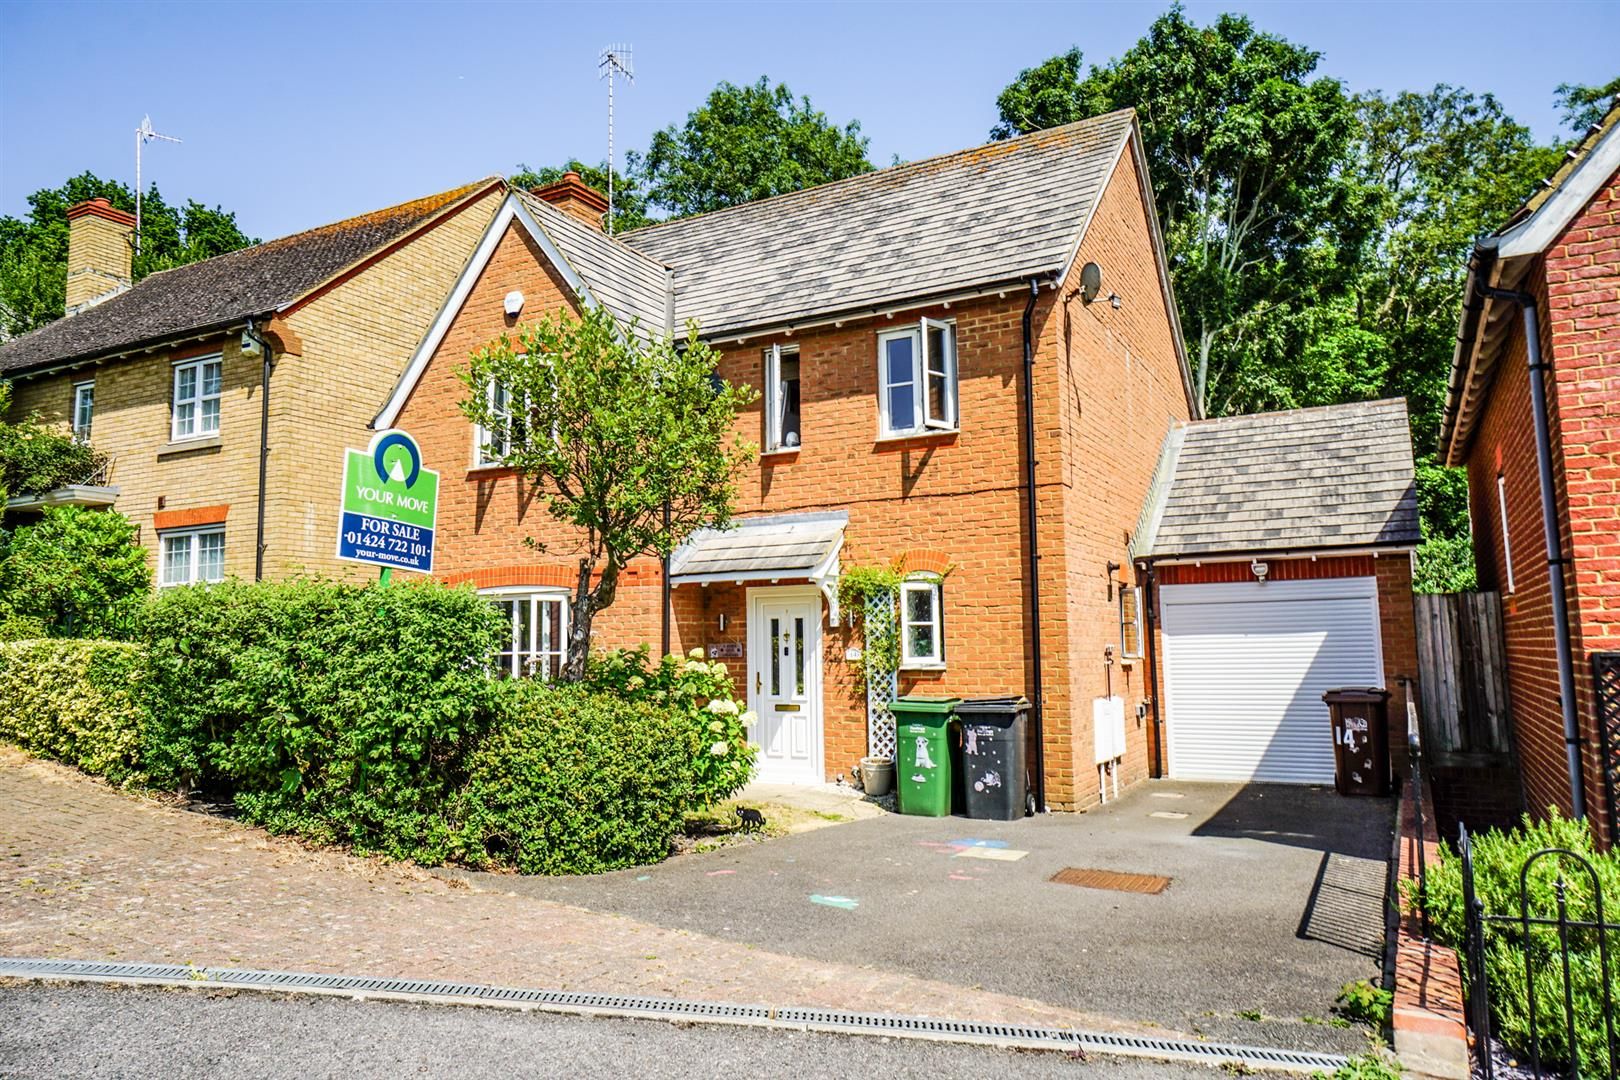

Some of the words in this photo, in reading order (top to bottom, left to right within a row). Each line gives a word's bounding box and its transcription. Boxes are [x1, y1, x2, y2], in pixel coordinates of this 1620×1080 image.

[356, 486, 393, 505] YOUR
[397, 495, 429, 514] MOVE
[361, 517, 390, 536] FOR
[392, 524, 420, 541] SALE
[388, 538, 407, 553] 722
[355, 548, 419, 566] your-move.co.uk
